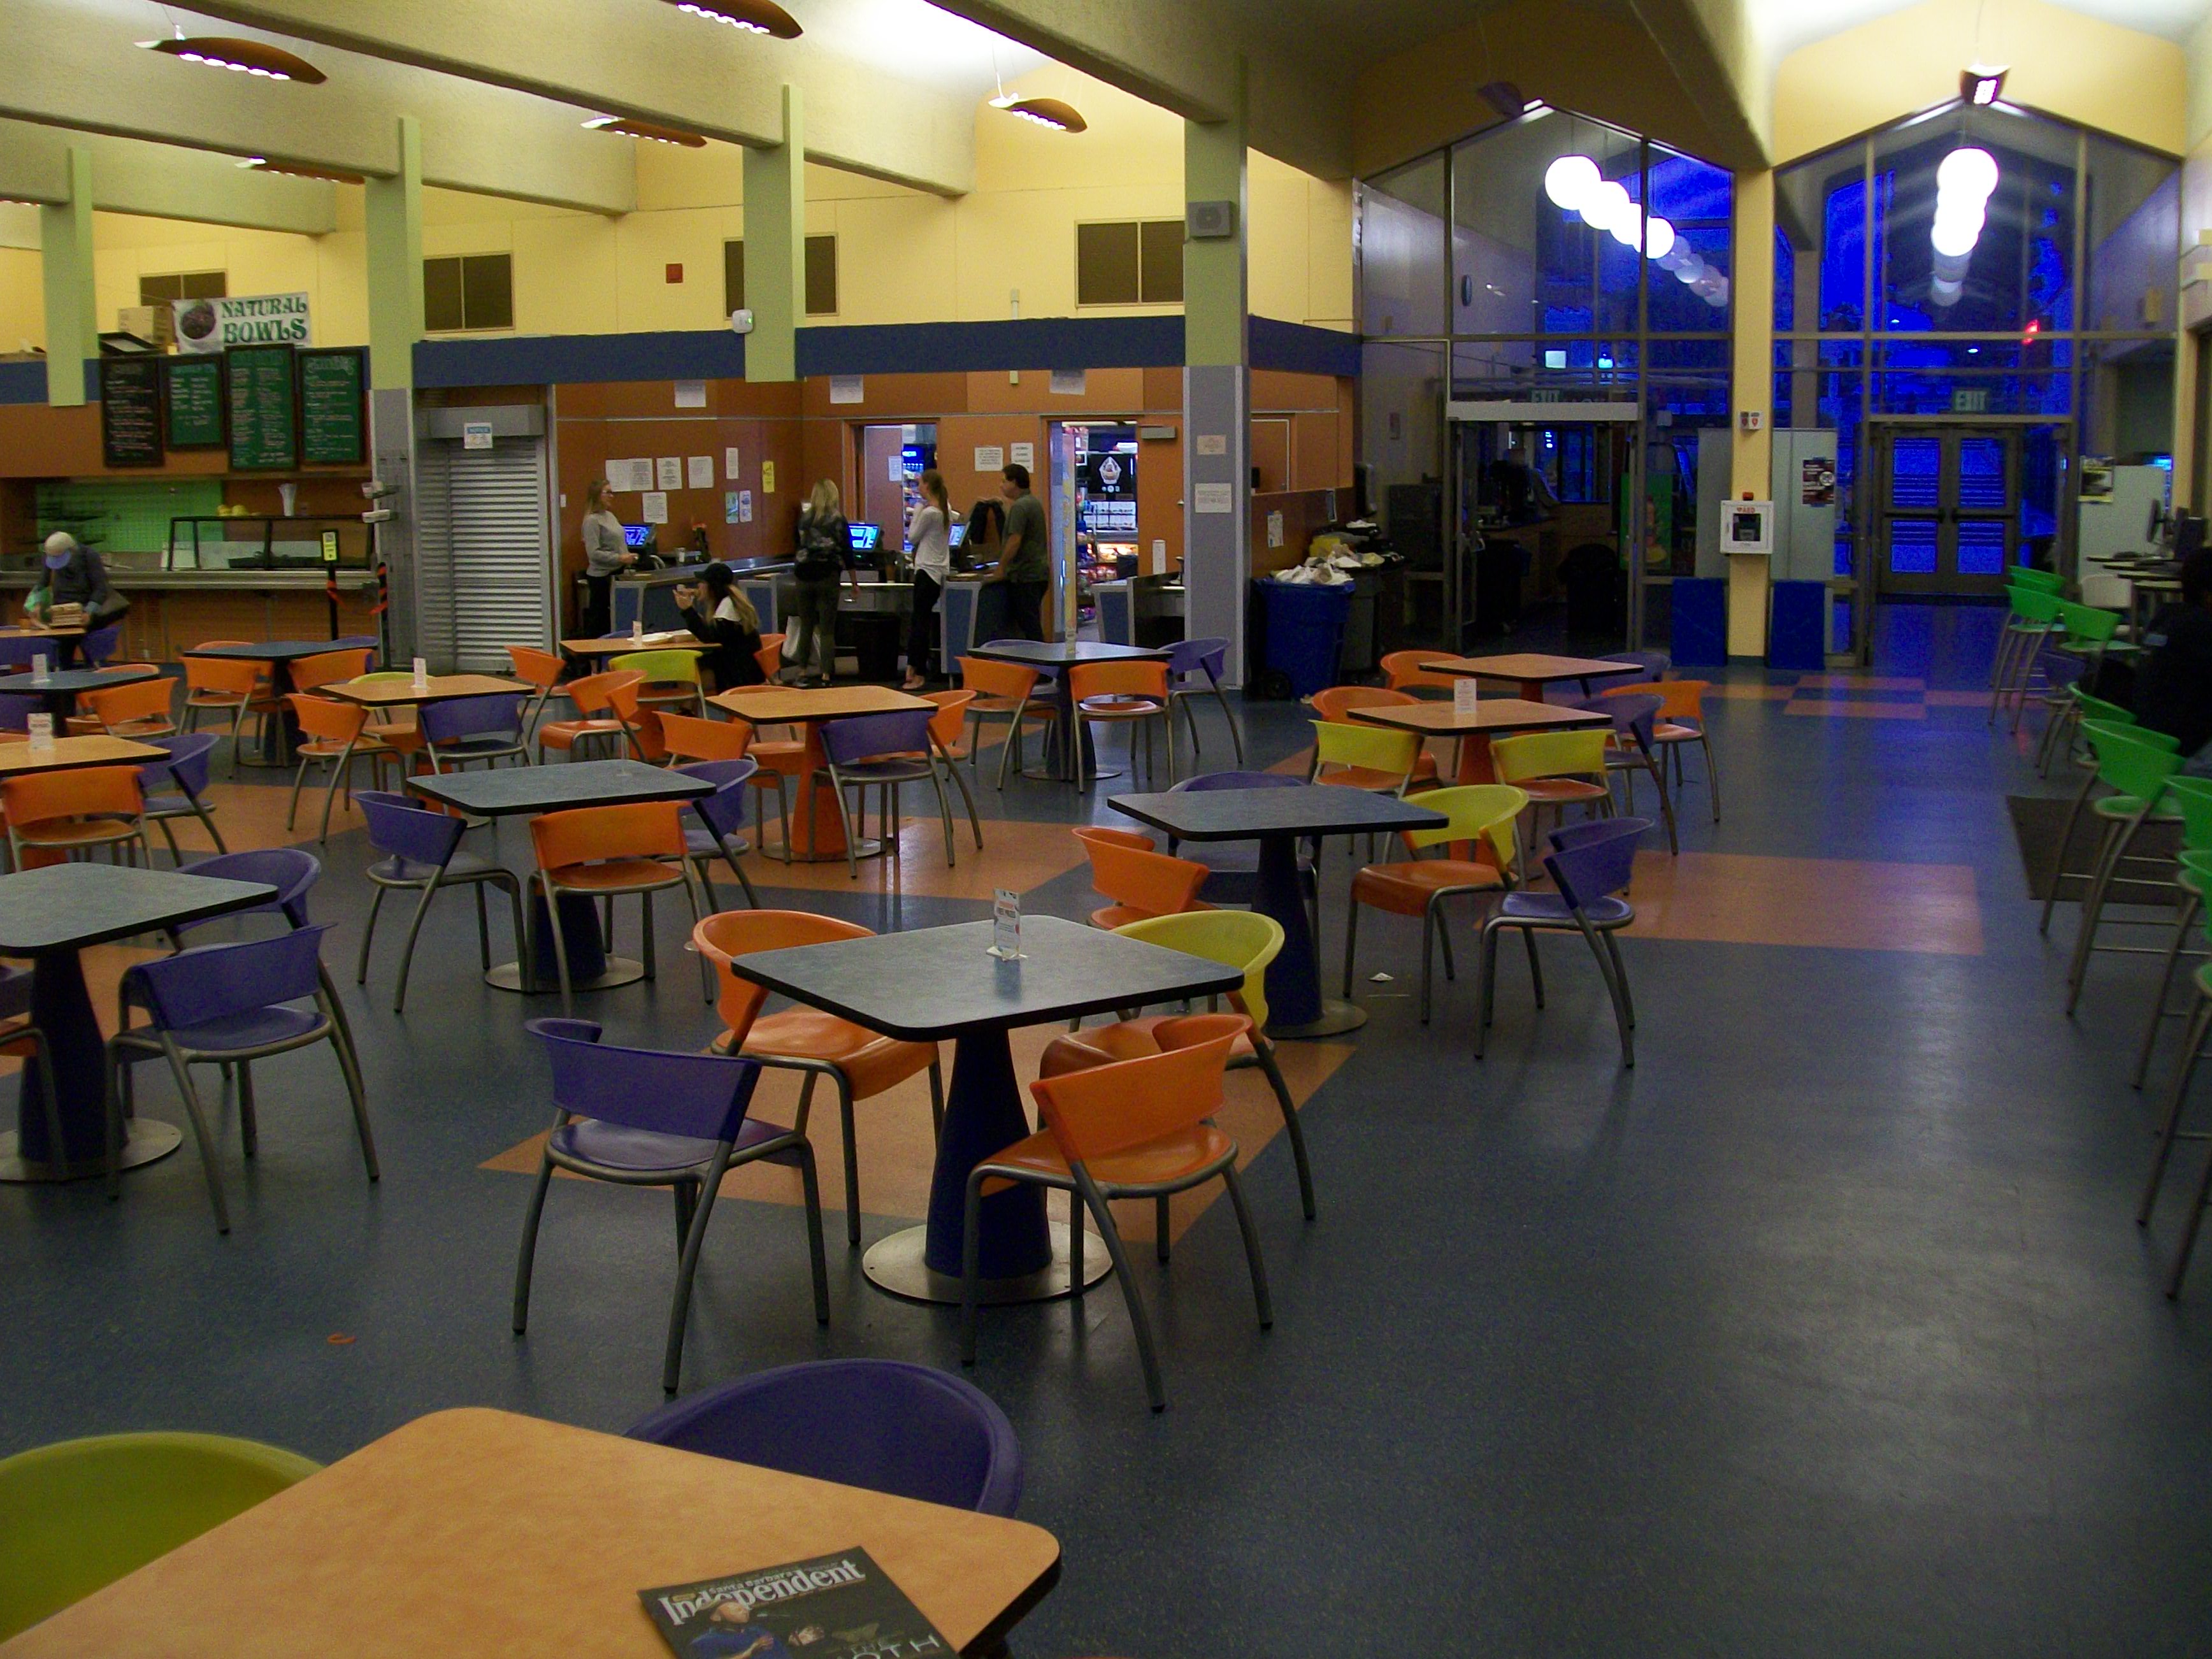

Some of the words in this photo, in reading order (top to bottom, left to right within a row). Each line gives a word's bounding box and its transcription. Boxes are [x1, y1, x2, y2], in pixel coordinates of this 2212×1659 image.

[222, 297, 307, 317] NATURAL
[224, 318, 307, 344] BOWLS
[1955, 391, 1986, 411] EXIT
